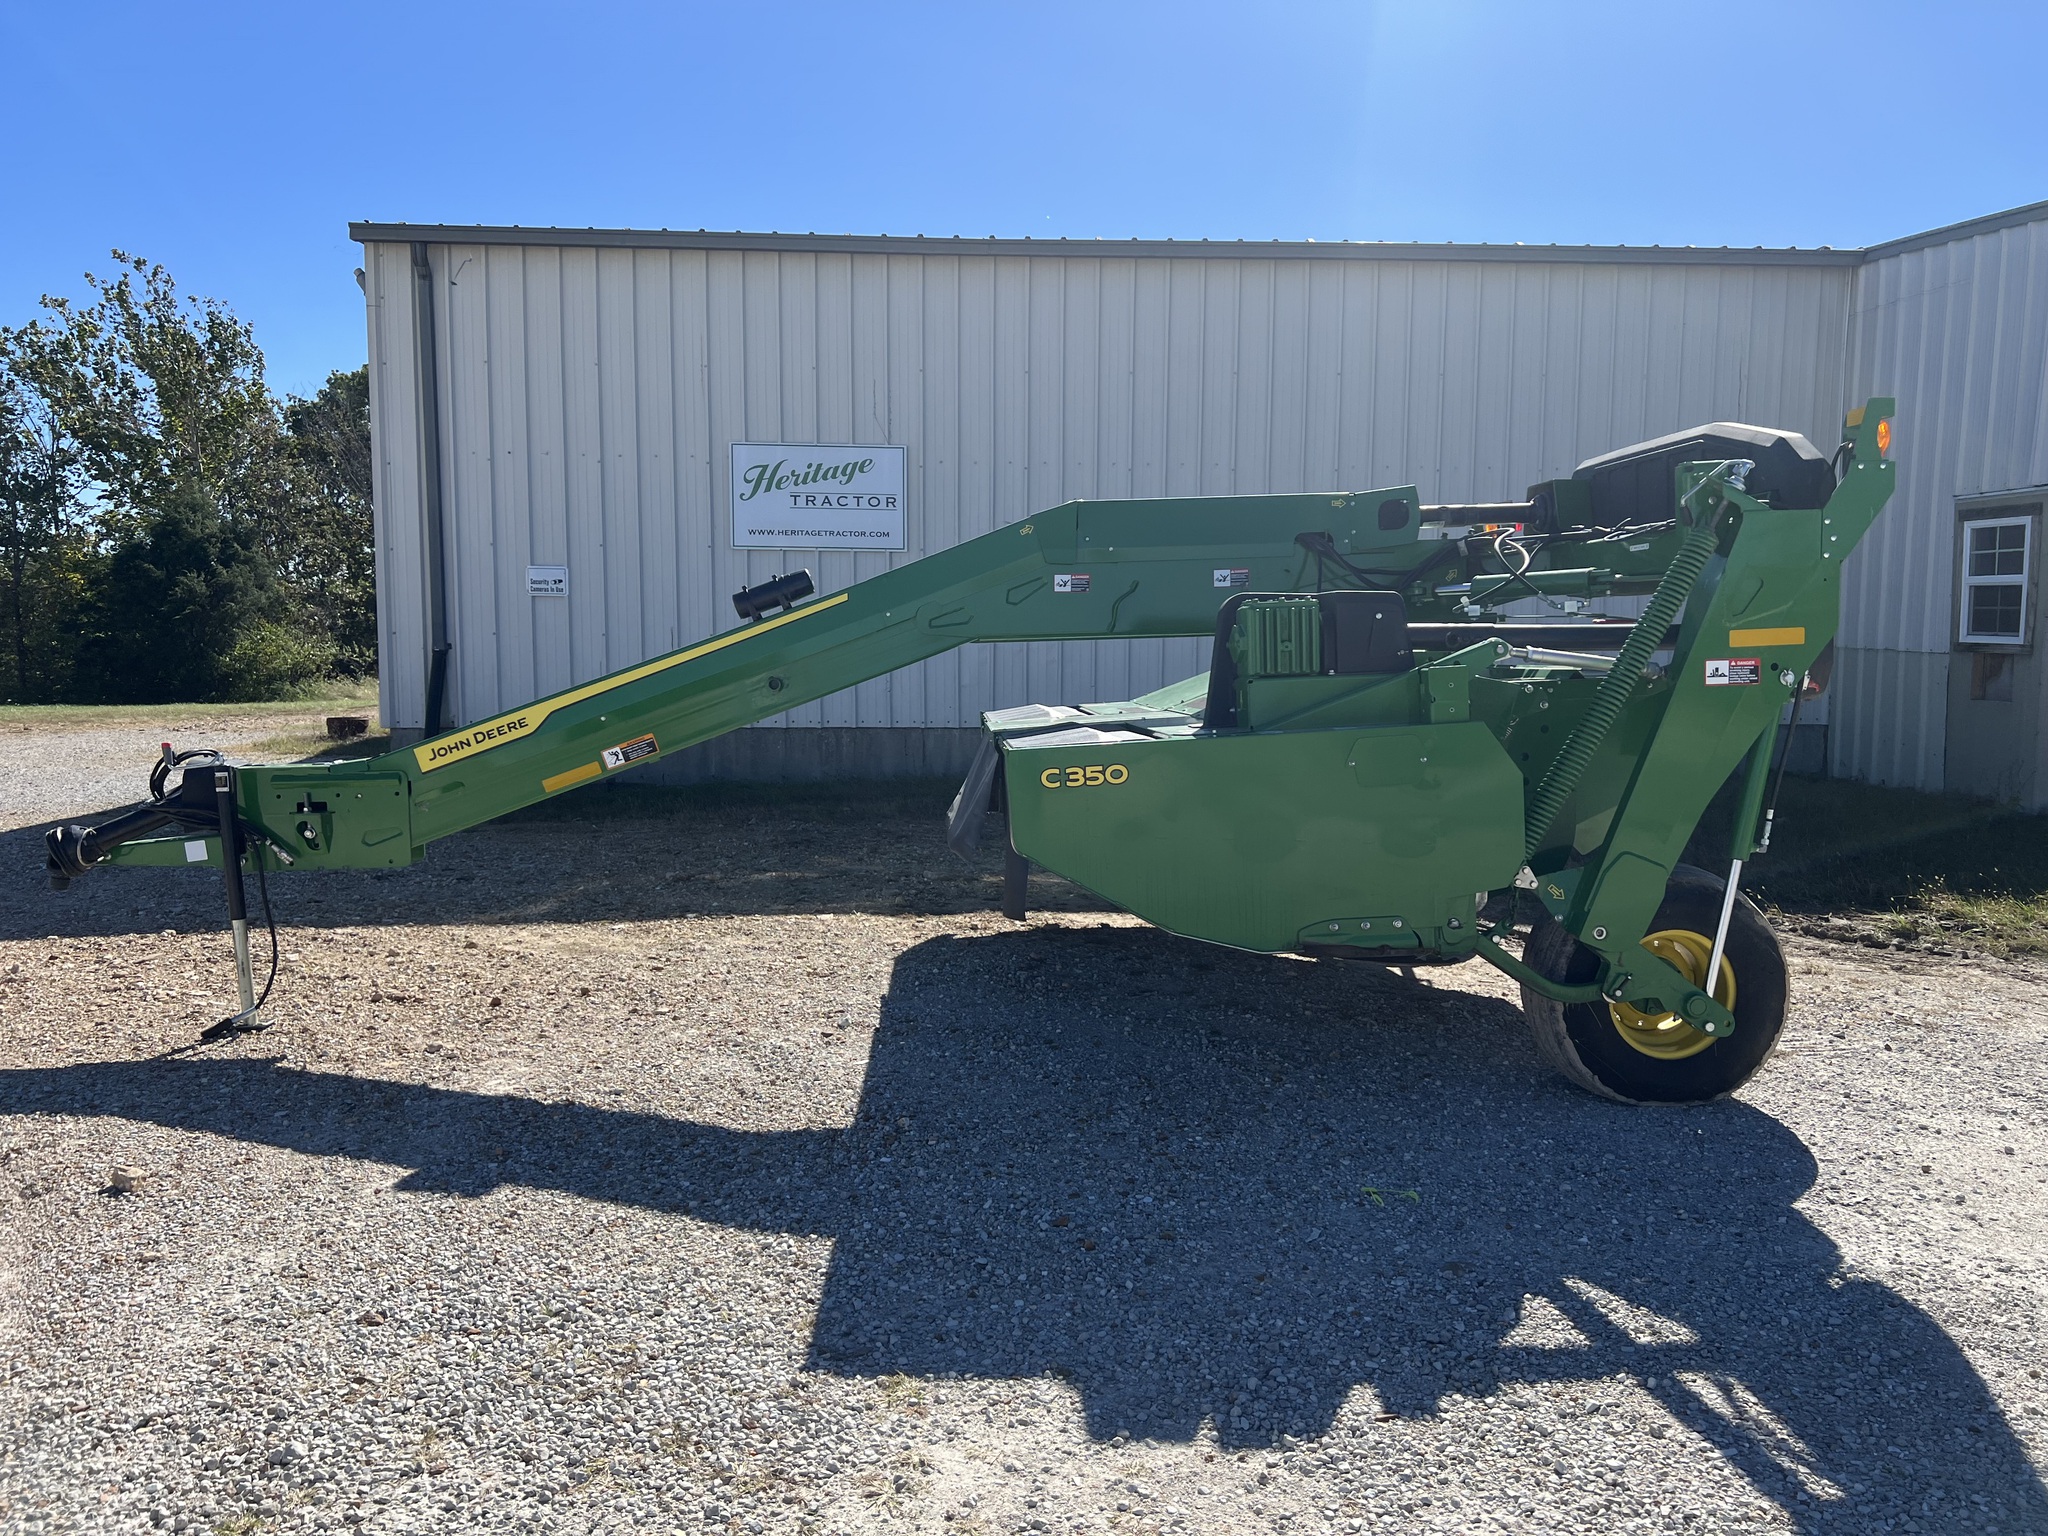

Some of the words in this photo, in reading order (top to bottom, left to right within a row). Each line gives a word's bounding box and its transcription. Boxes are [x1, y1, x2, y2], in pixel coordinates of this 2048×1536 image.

[739, 458, 876, 501] Heritage
[790, 494, 897, 508] TRACTOR
[748, 529, 890, 538] WWW.HERITAGETRACTOR.COM
[530, 578, 549, 586] Security
[428, 738, 472, 761] JOHN
[472, 717, 529, 744] DEERE
